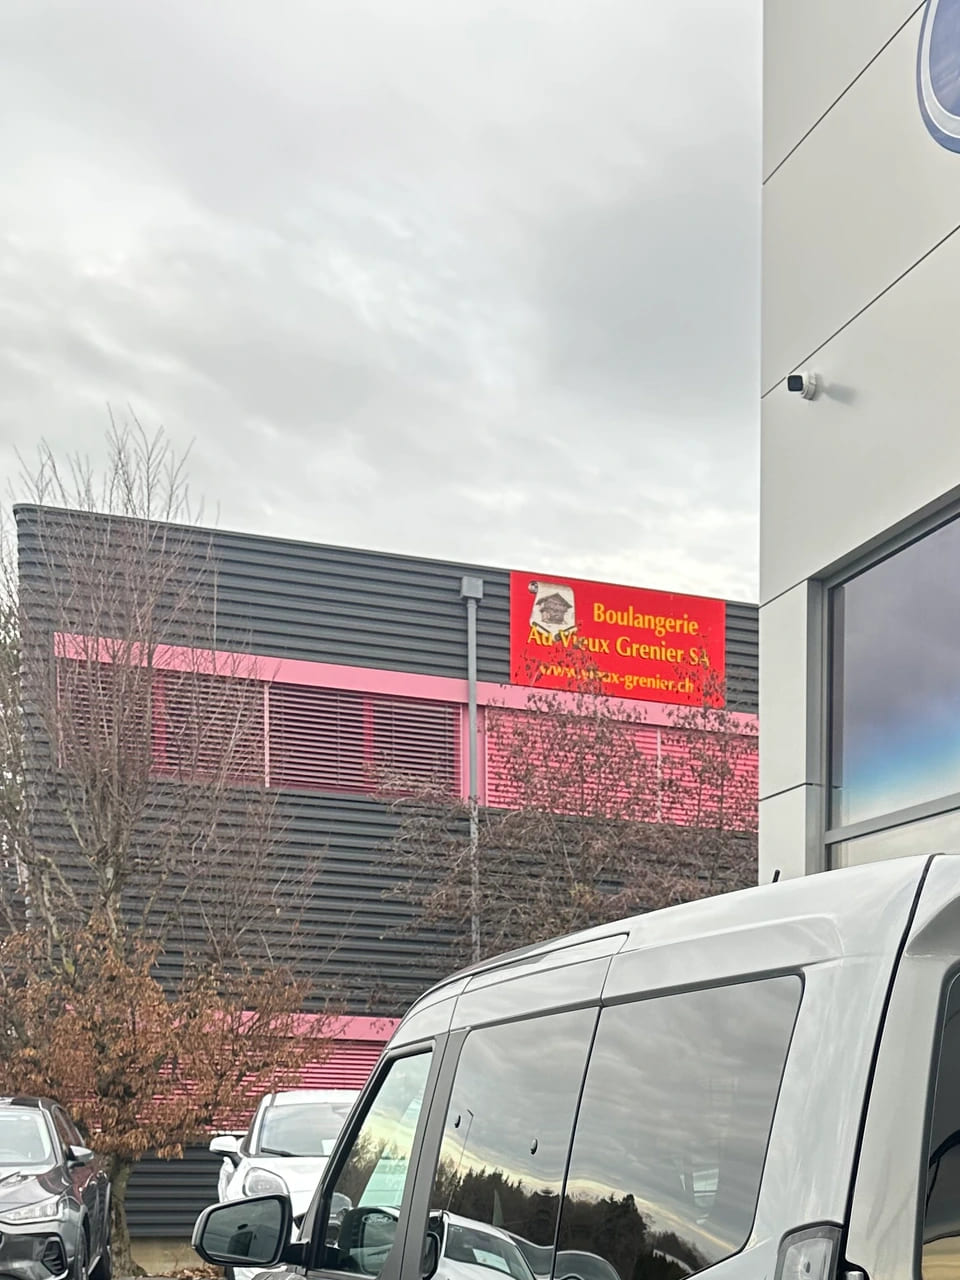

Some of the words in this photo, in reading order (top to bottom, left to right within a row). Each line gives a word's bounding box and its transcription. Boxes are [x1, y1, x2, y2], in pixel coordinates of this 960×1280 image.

[593, 602, 699, 638] Boulangerie
[527, 625, 553, 647] Au
[615, 636, 684, 663] Grenier
[689, 647, 710, 667] SA
